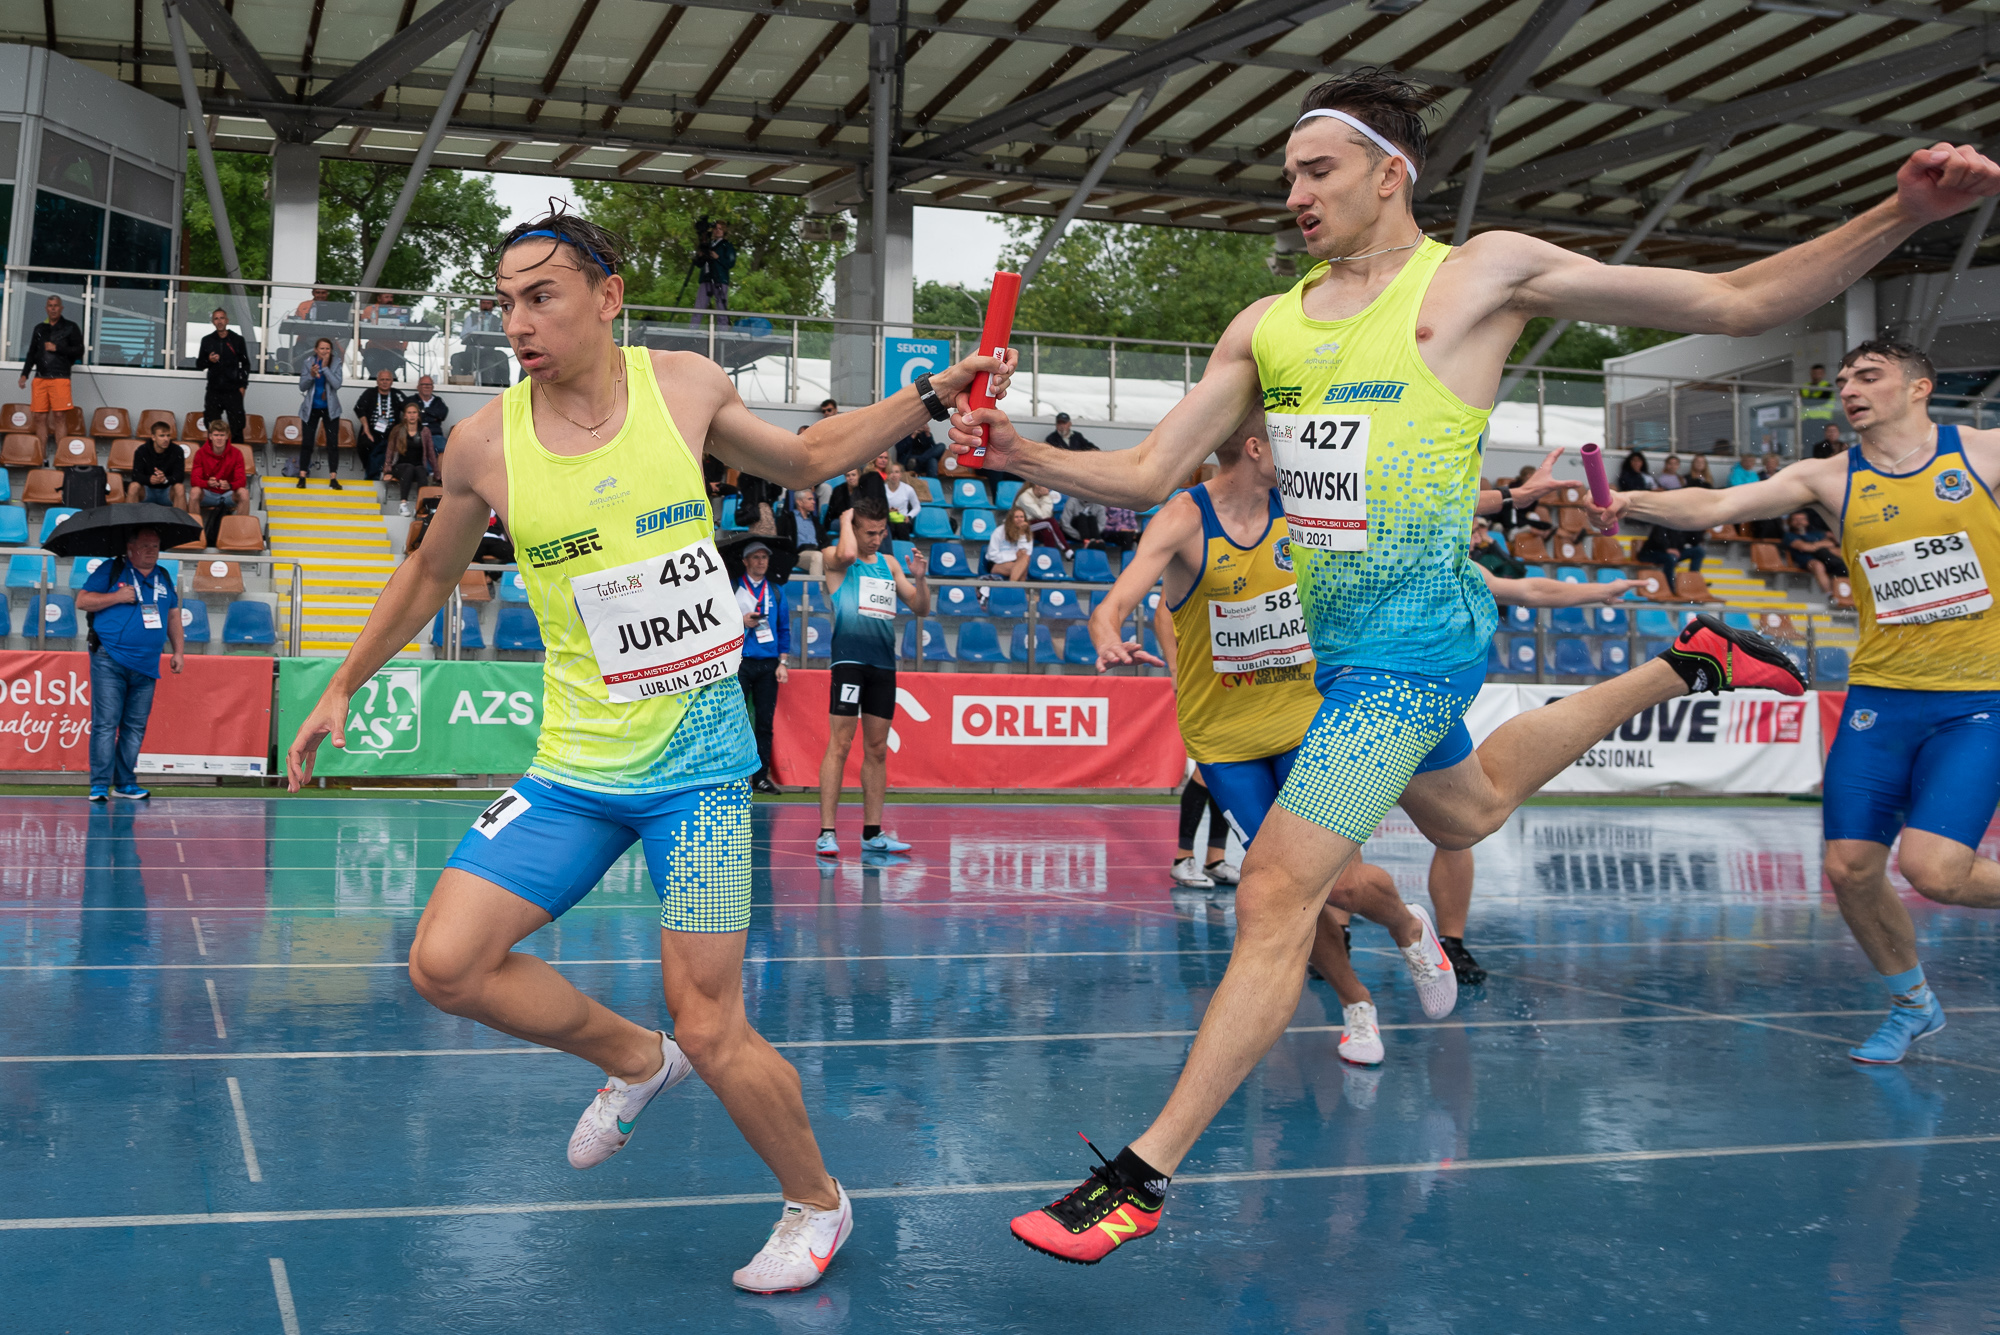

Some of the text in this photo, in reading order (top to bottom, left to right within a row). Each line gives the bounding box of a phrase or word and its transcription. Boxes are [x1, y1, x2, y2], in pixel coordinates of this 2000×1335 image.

[897, 343, 938, 355] SEKTOR
[1323, 382, 1408, 403] SONAROL
[1300, 421, 1360, 450] 427
[636, 501, 707, 536] SONAROL
[1317, 520, 1341, 528] POLSKI
[1306, 532, 1332, 547] 2021
[1914, 536, 1964, 560] 583
[658, 546, 719, 588] 431
[1873, 561, 1980, 602] KAROLEWSKI
[617, 597, 721, 654] JURAK
[1941, 604, 1969, 617] 2021
[1215, 618, 1308, 648] CHMIELARZ
[609, 637, 744, 683] 75. PZLA MISTRZOSTWA POLSKI U20
[1237, 655, 1297, 671] LUBLIN 2021
[639, 661, 728, 696] LUBLIN 2021
[846, 685, 856, 701] 7
[448, 690, 535, 726] AZS
[962, 703, 1097, 737] ORLEN
[0, 711, 58, 753] akuj
[480, 795, 518, 829] 4
